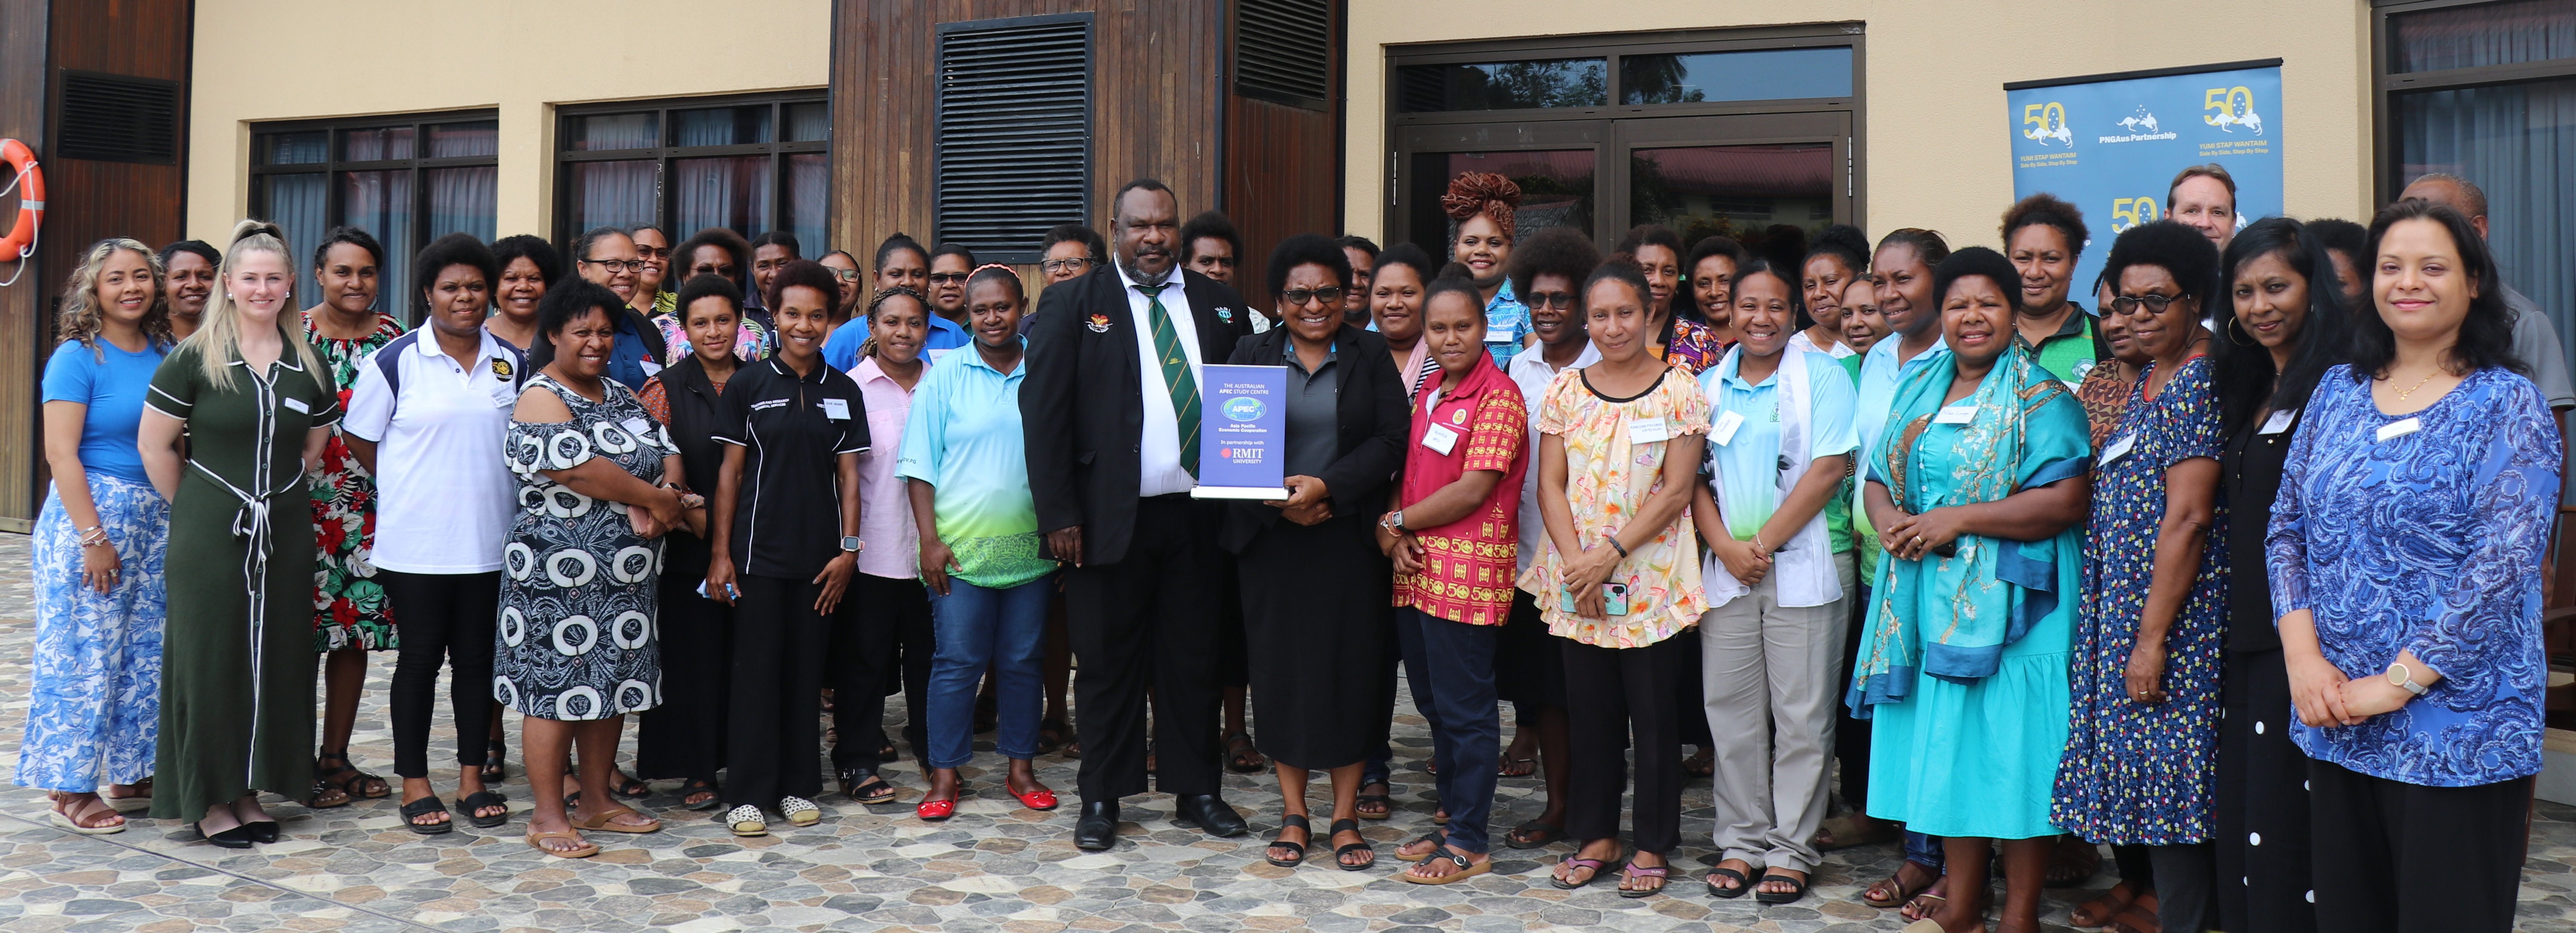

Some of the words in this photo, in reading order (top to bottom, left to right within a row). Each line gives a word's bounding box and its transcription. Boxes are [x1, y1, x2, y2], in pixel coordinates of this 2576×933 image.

[2204, 86, 2253, 126] 50
[2023, 102, 2065, 140] 50
[2099, 135, 2130, 144] PNGAus
[2131, 132, 2177, 141] Partnership
[2112, 196, 2158, 234] 50
[1498, 399, 1510, 408] 50
[1509, 401, 1518, 411] 50
[1491, 423, 1503, 431] 50
[1503, 424, 1514, 434] 50
[1232, 448, 1264, 458] RMIT
[1496, 448, 1508, 457] 50
[1426, 536, 1449, 550] 50
[1451, 539, 1474, 554] 50
[1475, 542, 1493, 556] 50
[1493, 544, 1509, 558] 50
[1417, 574, 1428, 590] 50
[1428, 578, 1445, 595] 50
[1446, 583, 1470, 599] 50
[1471, 586, 1493, 601] 50
[1495, 589, 1508, 602] 50
